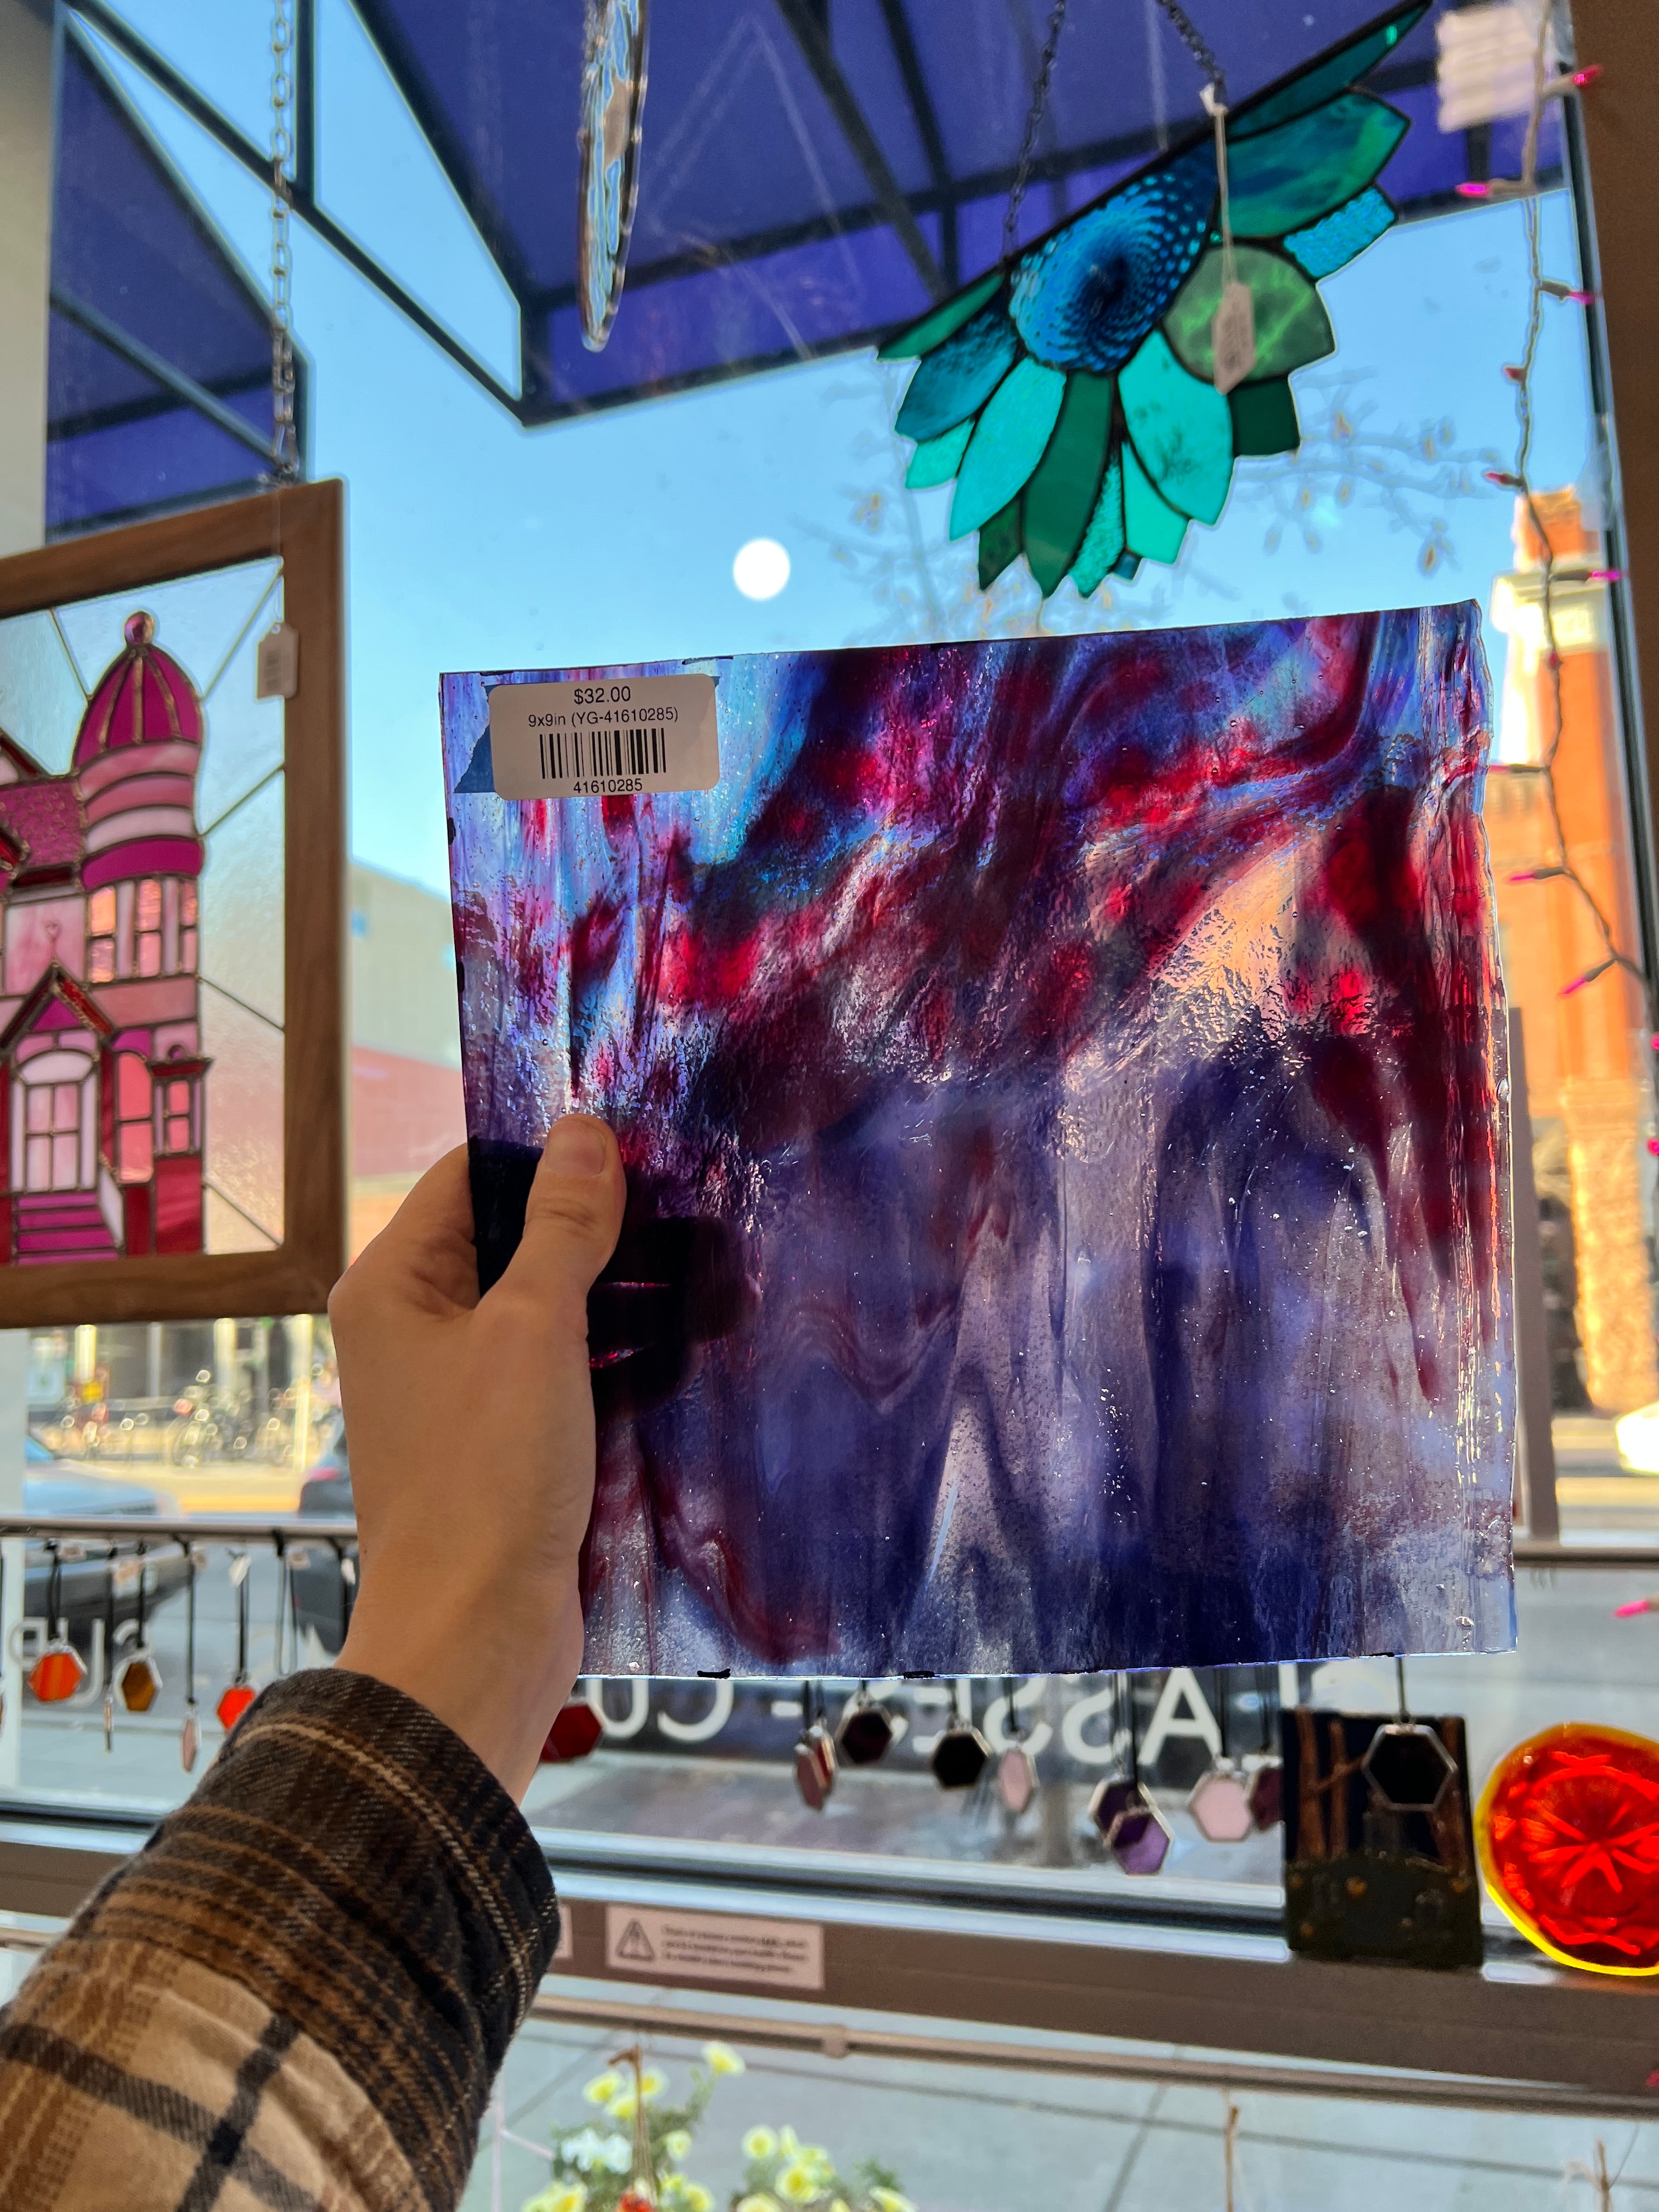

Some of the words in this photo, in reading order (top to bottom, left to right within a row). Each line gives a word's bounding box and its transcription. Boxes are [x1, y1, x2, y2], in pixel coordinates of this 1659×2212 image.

[574, 686, 631, 704] $32.00
[528, 713, 566, 727] 9x9in
[572, 707, 678, 727] (YG-41610285)
[573, 778, 642, 794] 41610285
